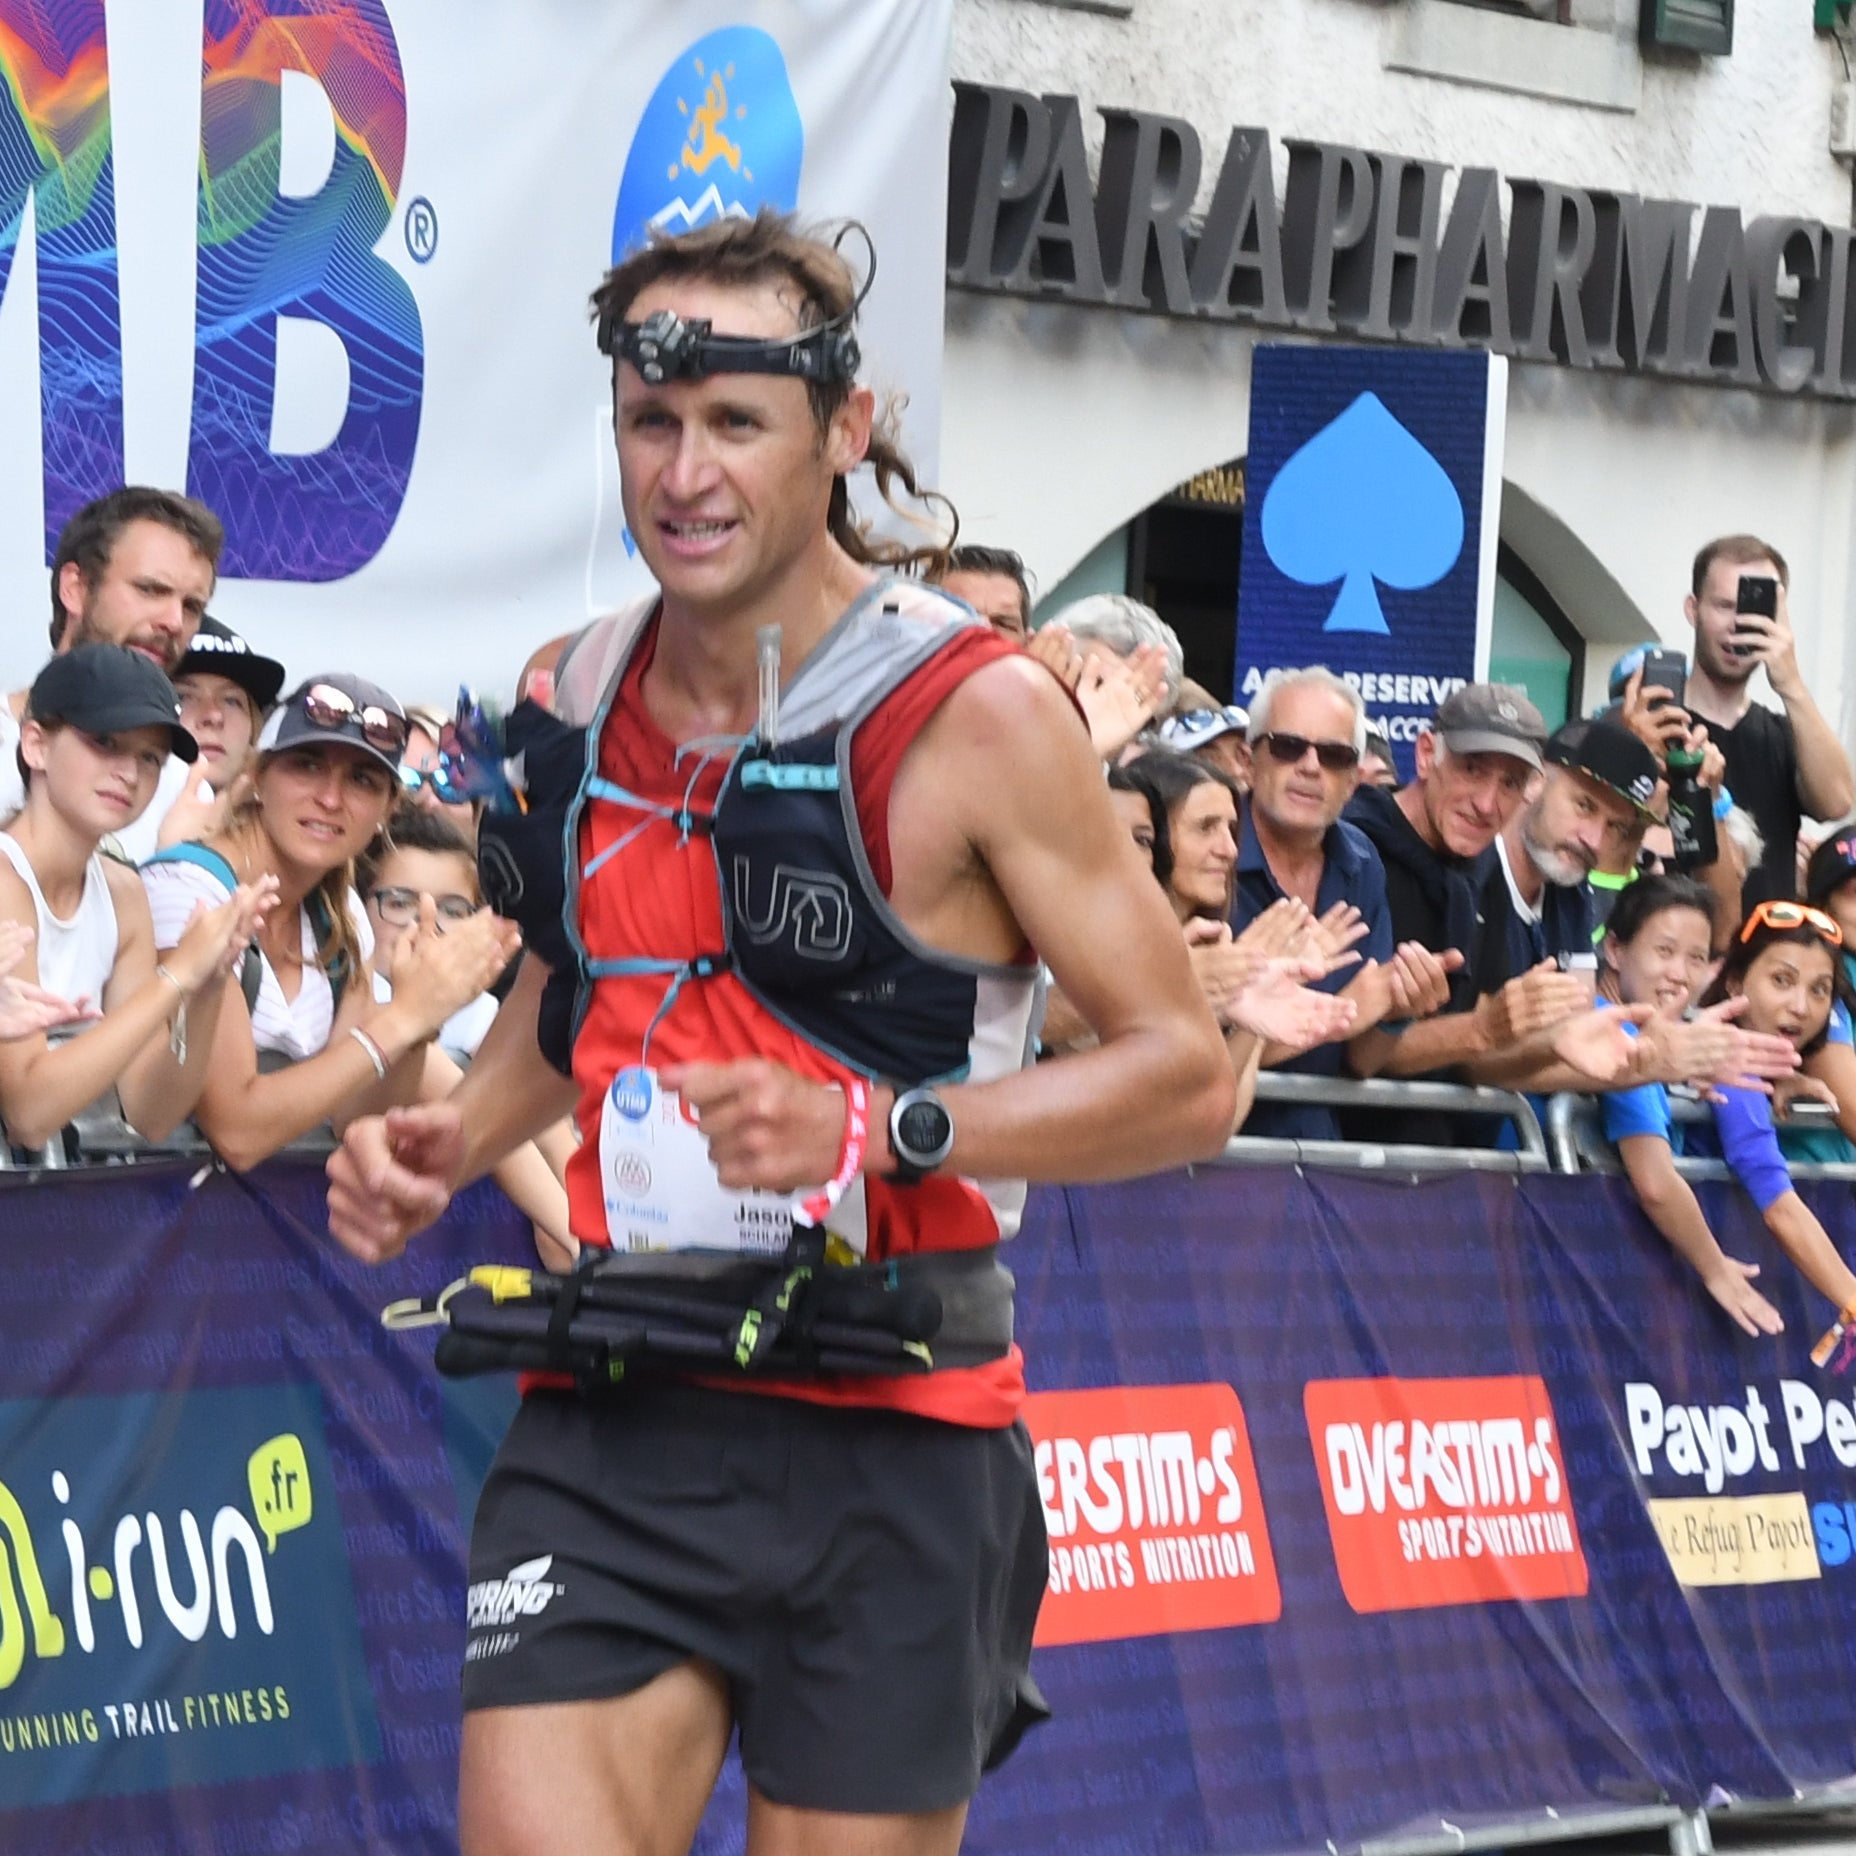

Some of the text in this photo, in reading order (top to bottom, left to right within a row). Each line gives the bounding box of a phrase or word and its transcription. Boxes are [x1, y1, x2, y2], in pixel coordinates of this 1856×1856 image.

[1624, 1382, 1781, 1494] Payot
[51, 1469, 276, 1655] i-run
[1046, 1533, 1256, 1594] SPORTS NUTRITION
[1397, 1515, 1483, 1563] SPORTS
[103, 1697, 180, 1741] TRAIL
[182, 1685, 293, 1731] FITNESS
